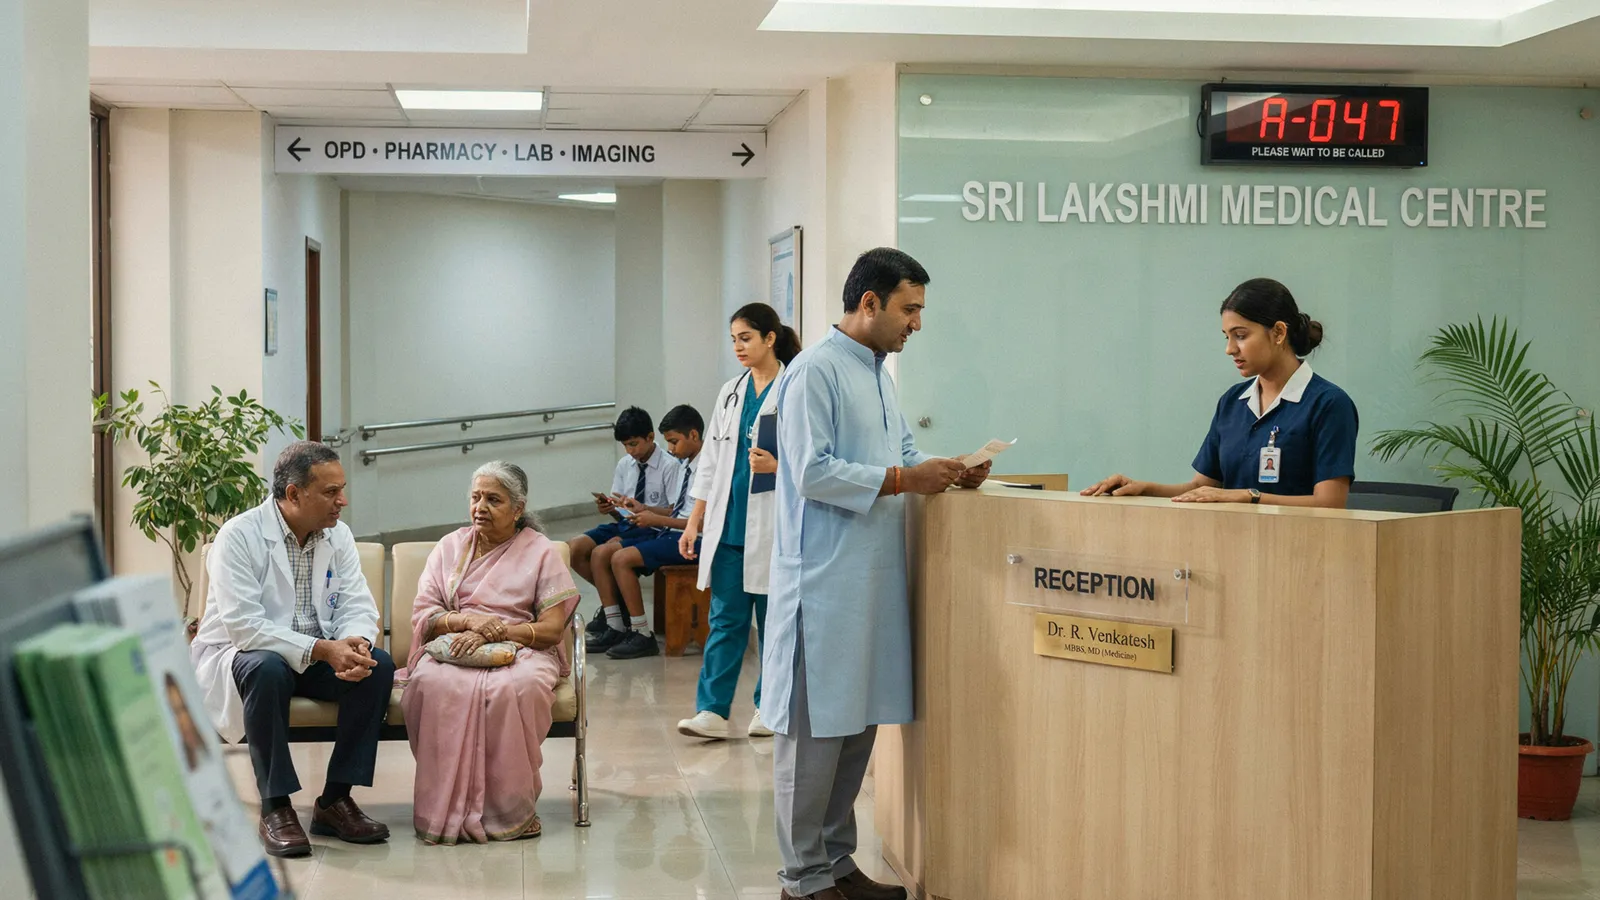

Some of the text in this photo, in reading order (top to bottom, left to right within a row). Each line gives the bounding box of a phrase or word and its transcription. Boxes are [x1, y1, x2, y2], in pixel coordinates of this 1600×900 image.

[1259, 97, 1400, 143] A-047
[324, 141, 655, 163] OPD PHARMACY LAB IMAGING
[1251, 146, 1385, 158] PLEASE WAIT TO BE CALLED
[961, 181, 1547, 228] SRI LAKSHMI MEDICAL CENTRE
[1034, 567, 1155, 601] RECEPTION
[1047, 621, 1156, 650] Dr. R. Venkatesh
[1064, 644, 1137, 662] MBBS, MD (Medicine)
